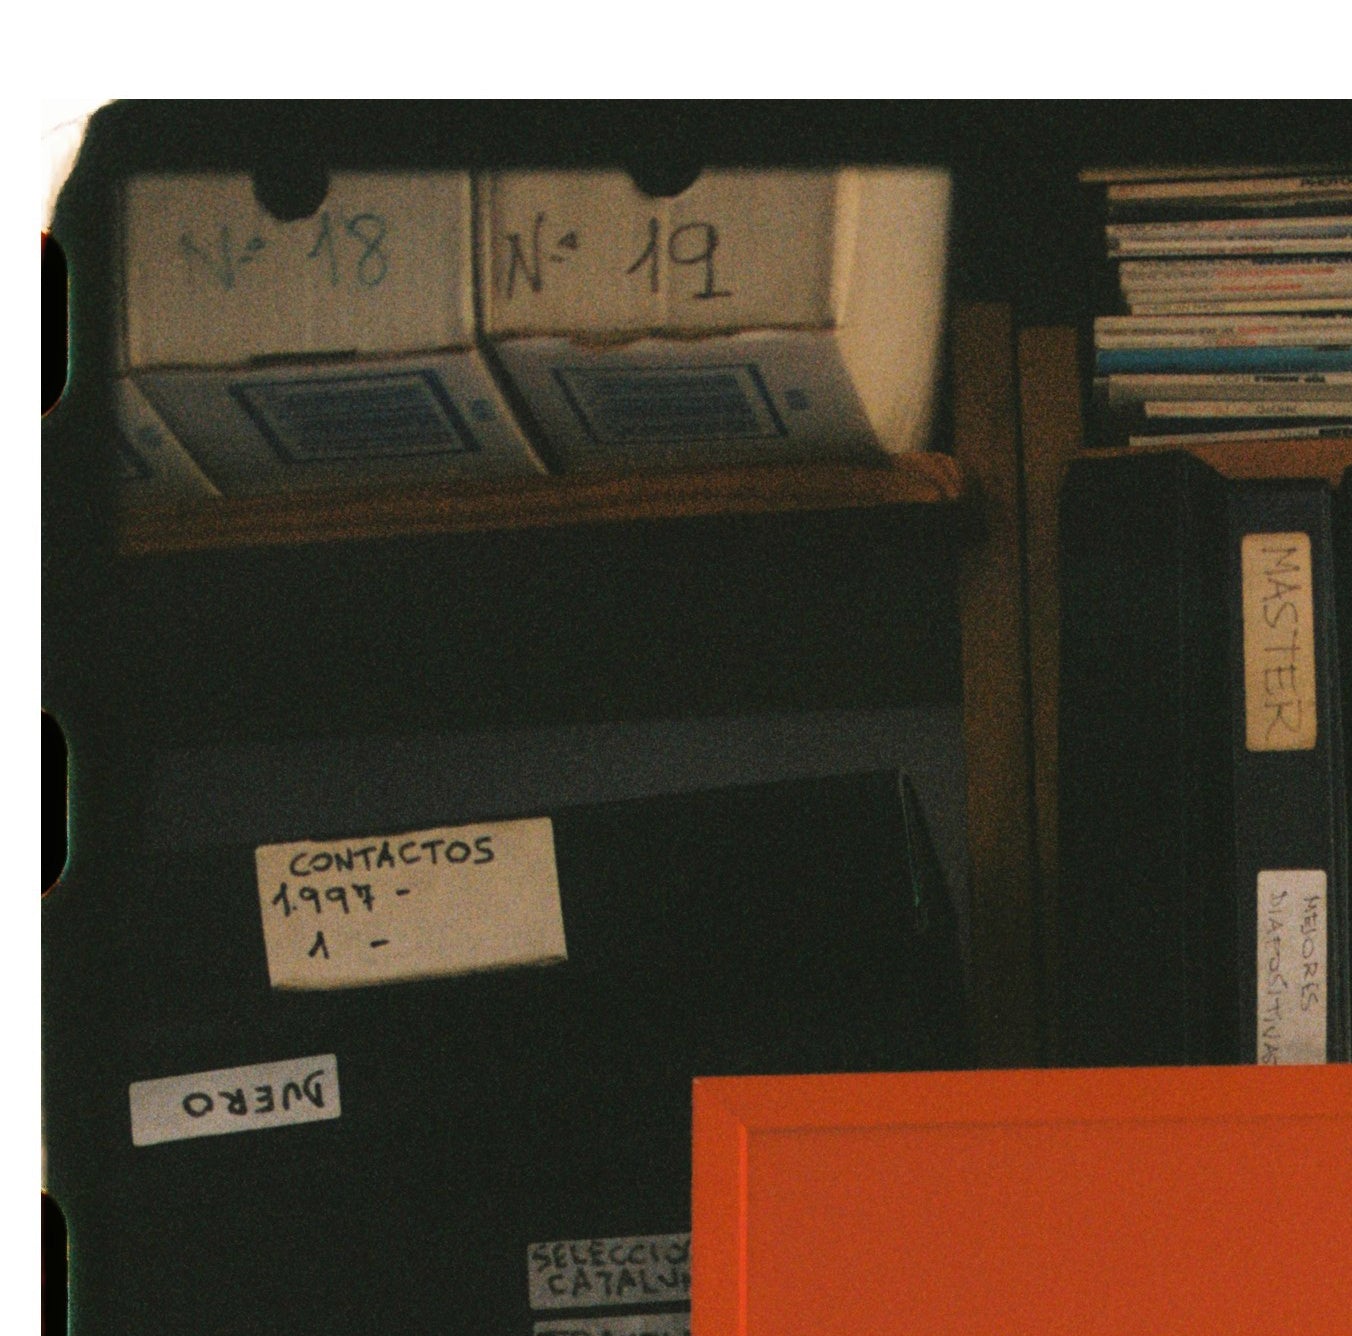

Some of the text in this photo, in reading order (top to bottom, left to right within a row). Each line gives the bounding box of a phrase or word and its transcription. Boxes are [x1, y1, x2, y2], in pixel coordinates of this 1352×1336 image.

[309, 203, 390, 288] 18
[627, 215, 733, 298] 19
[1260, 546, 1302, 743] MASTER
[289, 836, 496, 878] CONTACTOS
[182, 1069, 329, 1118] DUERO
